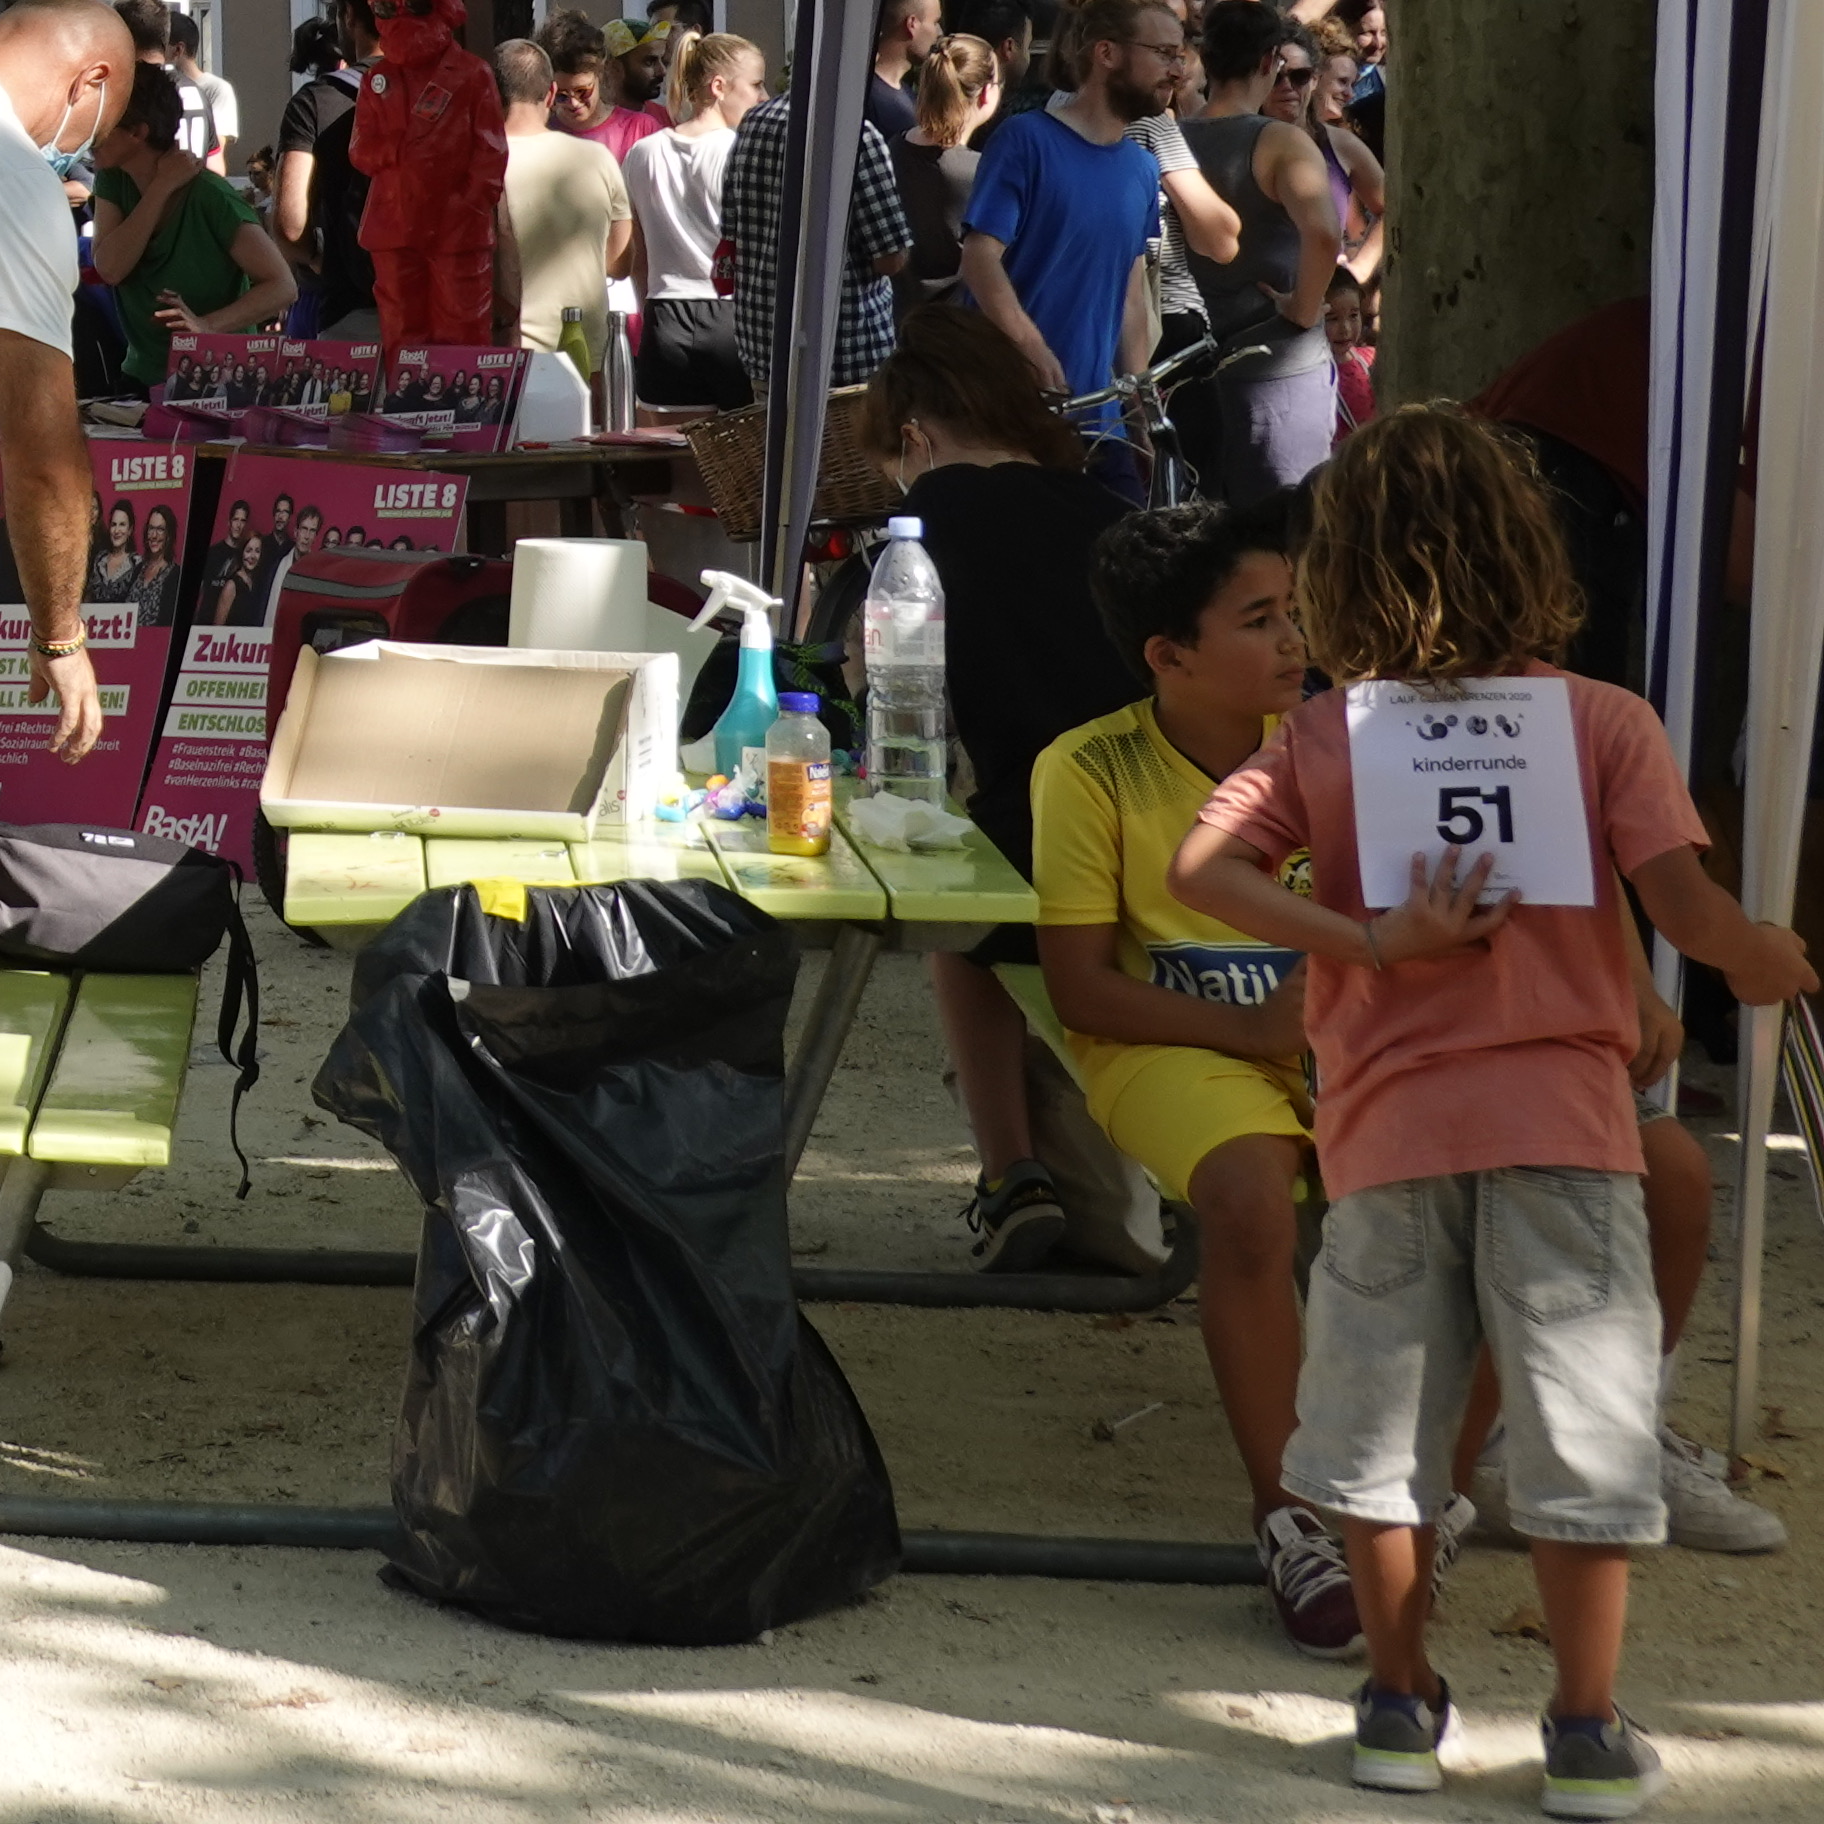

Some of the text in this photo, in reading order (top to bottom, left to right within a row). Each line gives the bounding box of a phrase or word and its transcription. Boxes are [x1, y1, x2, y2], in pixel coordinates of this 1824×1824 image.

[110, 455, 186, 482] LISTE 8
[373, 483, 457, 509] LISTE 8
[185, 680, 266, 700] OFFENHEI
[1508, 691, 1533, 702] 2020
[177, 713, 266, 733] ENTSCHLOS
[172, 742, 235, 757] #Frauenstreik
[168, 758, 234, 773] #Baselnazifrei
[1412, 754, 1528, 773] kinderrunde
[164, 775, 240, 789] #vonHerzenlinks
[1435, 785, 1515, 845] 51
[142, 805, 228, 852] BastA!
